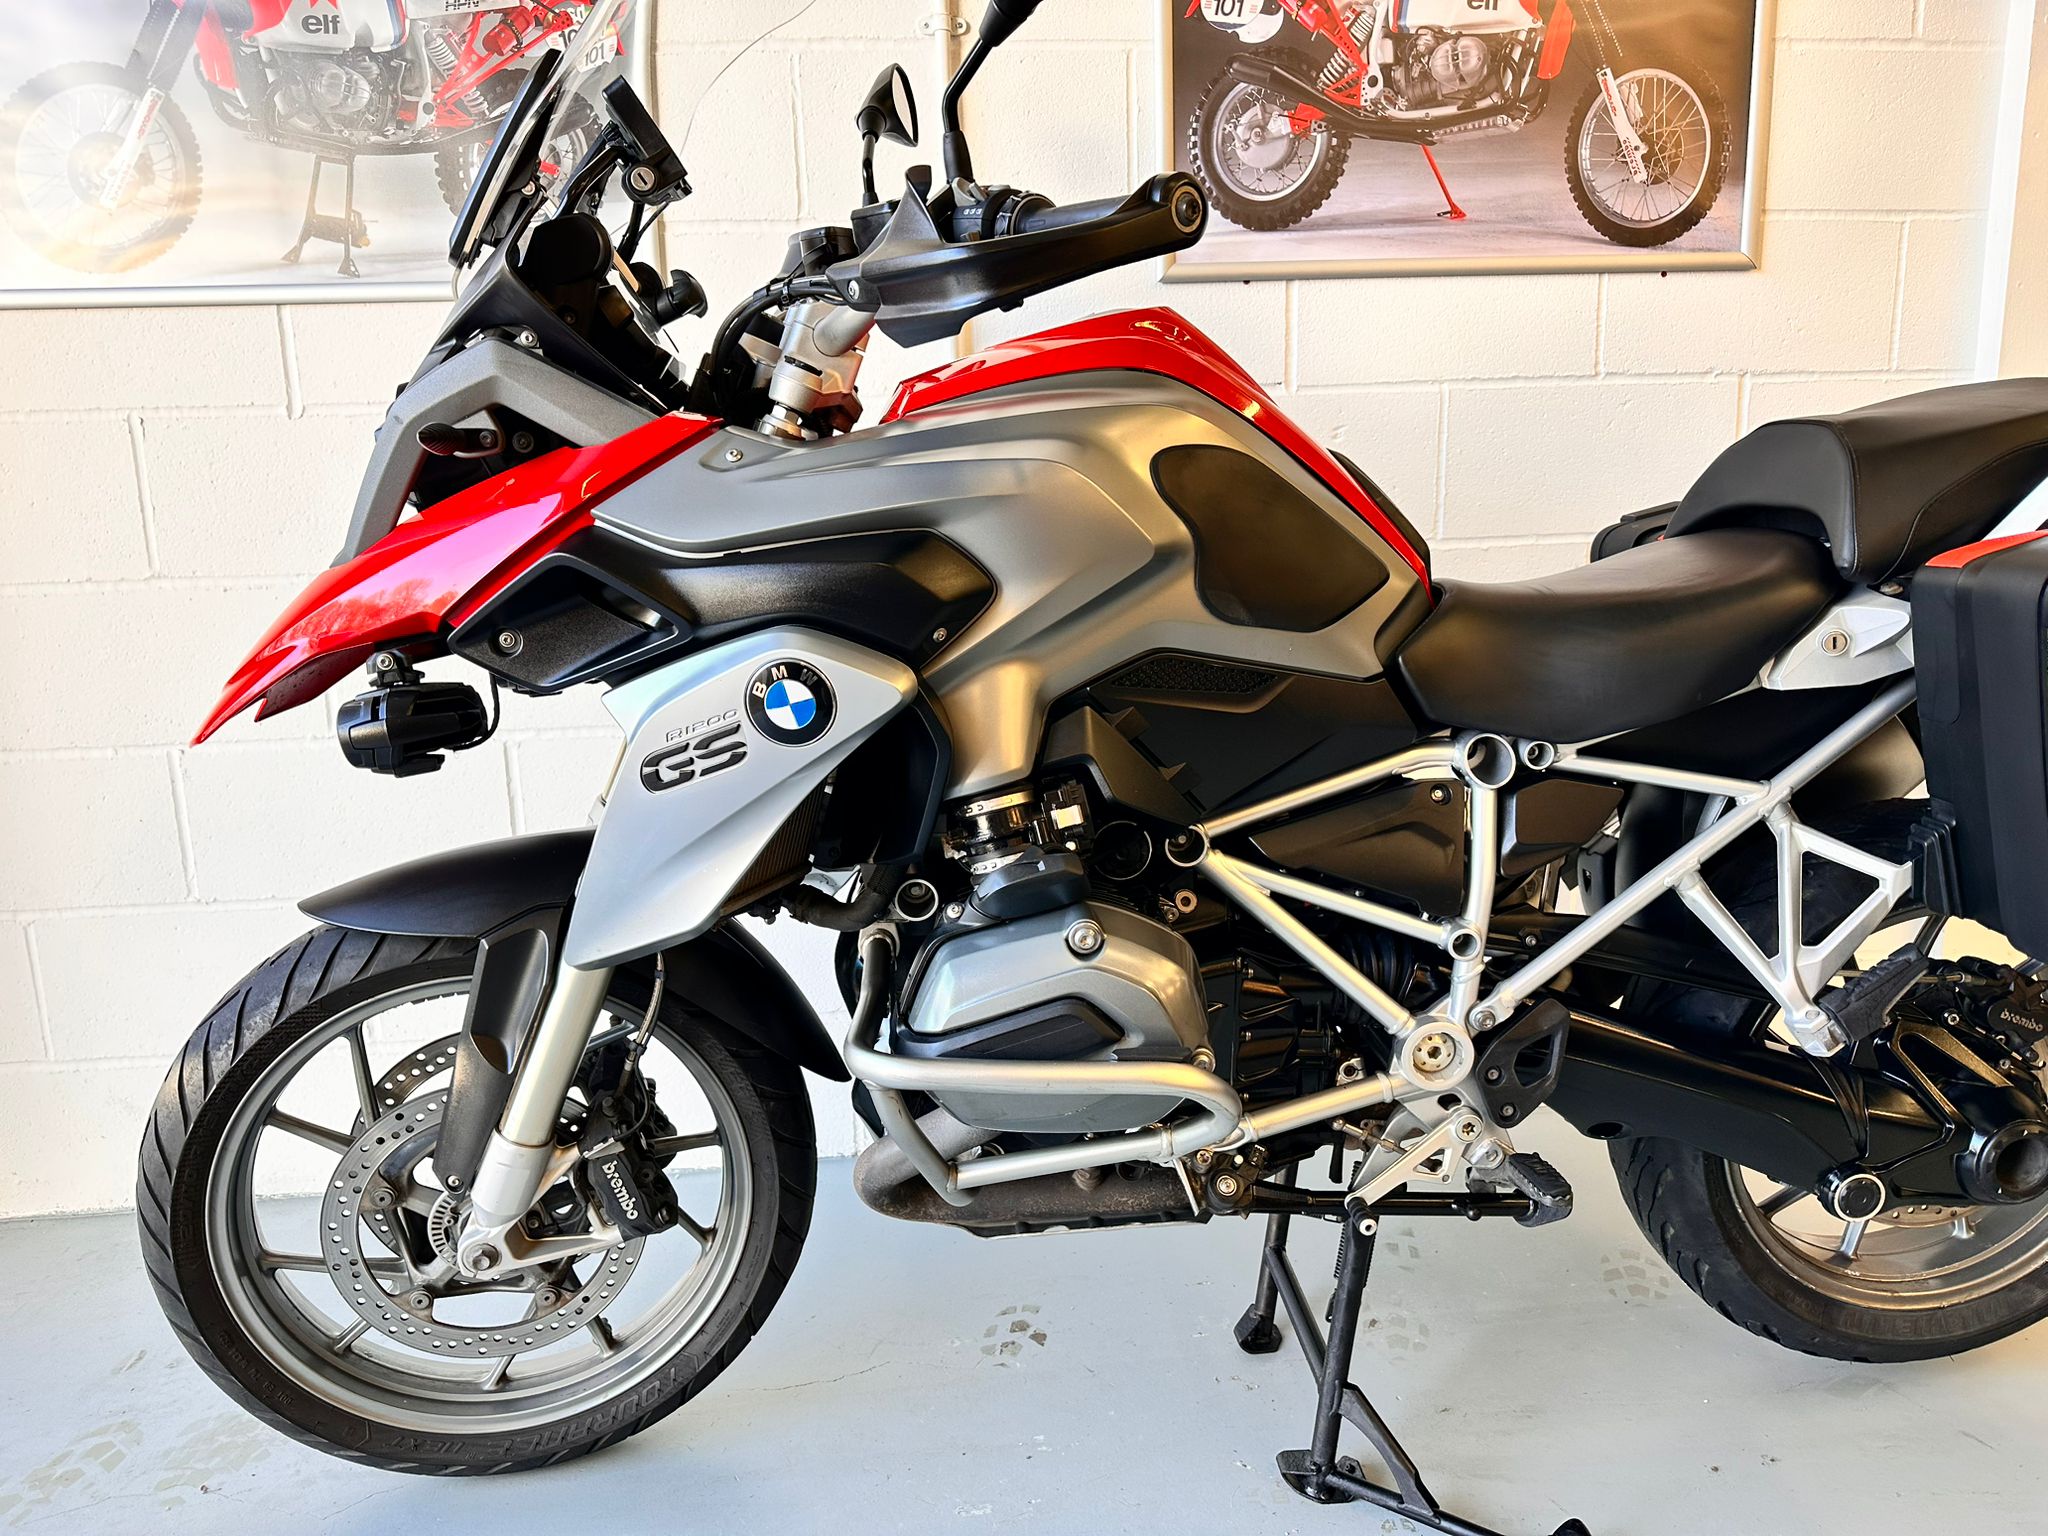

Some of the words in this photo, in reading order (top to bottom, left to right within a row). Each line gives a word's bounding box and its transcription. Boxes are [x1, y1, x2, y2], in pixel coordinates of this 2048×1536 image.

[1213, 0, 1245, 17] 101
[301, 14, 340, 35] elf
[585, 42, 606, 62] 101
[751, 664, 818, 699] BMW
[640, 722, 748, 794] GS
[2000, 1008, 2043, 1032] brembo
[601, 1160, 639, 1220] brembo
